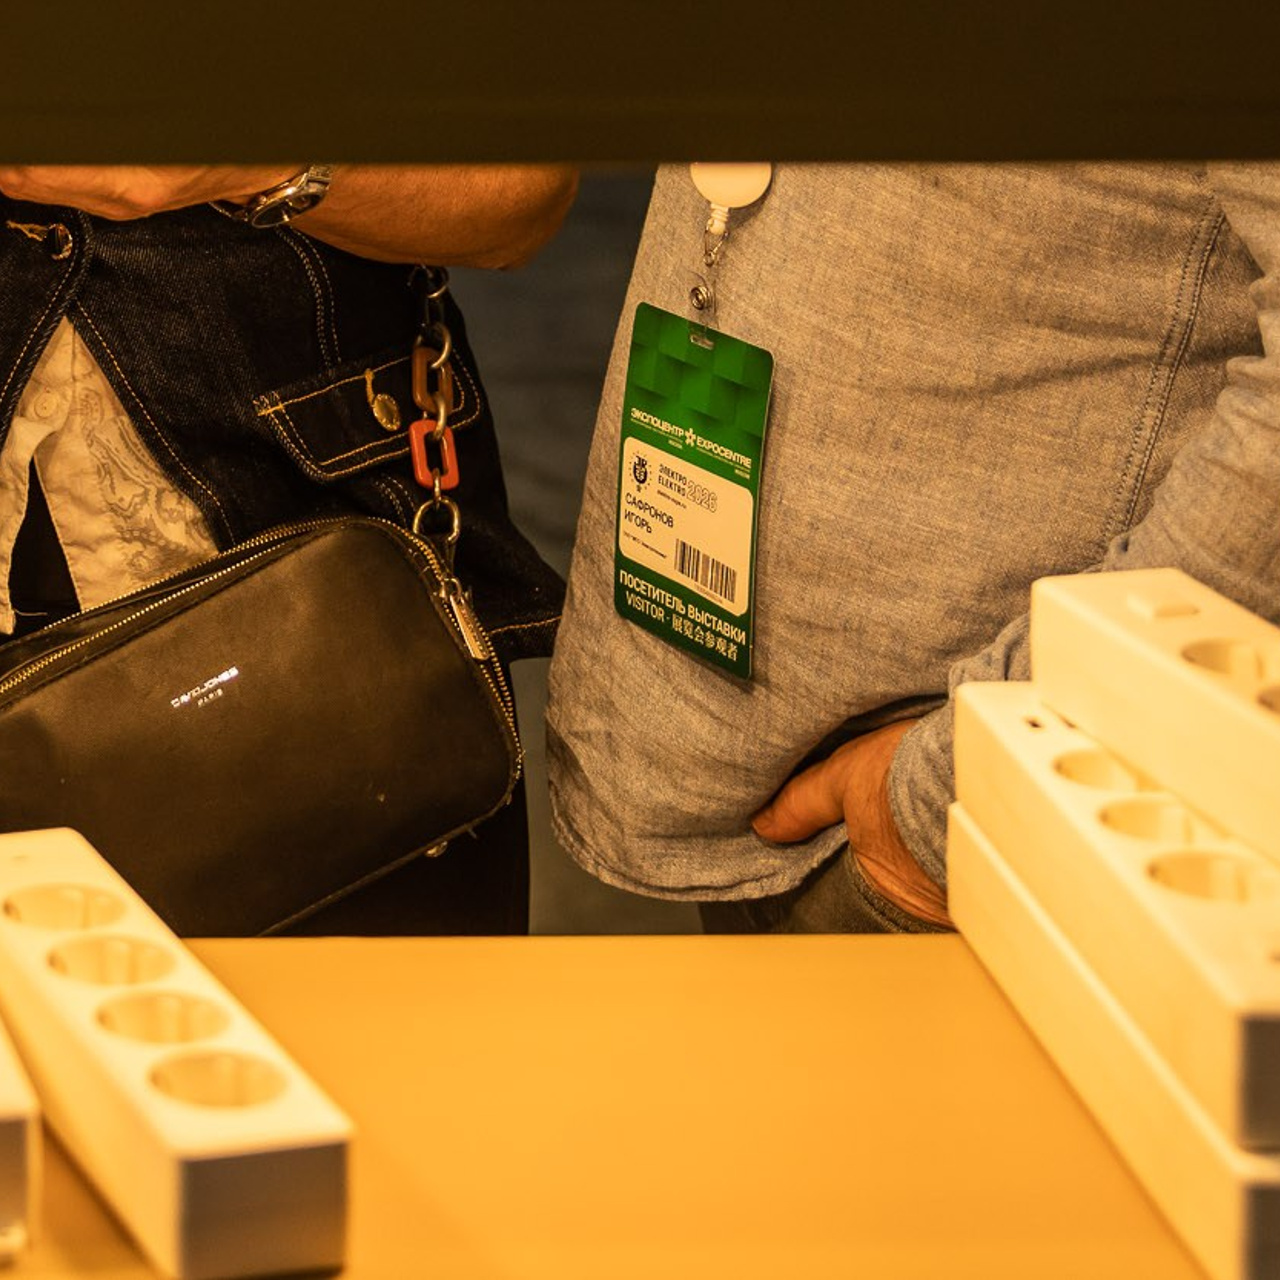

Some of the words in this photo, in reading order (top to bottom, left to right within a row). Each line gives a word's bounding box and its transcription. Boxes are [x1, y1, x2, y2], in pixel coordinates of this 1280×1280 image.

[630, 407, 684, 437] ЭКСПОЦЕНТР
[696, 435, 752, 469] EXPOCENTRE
[658, 475, 686, 497] ELEKTRO
[686, 480, 718, 514] 2026
[624, 509, 652, 534] ИГОРЬ
[625, 492, 674, 528] САФРОНОВ
[619, 569, 686, 615] ПОСЕТИТЕЛЬ
[687, 604, 746, 645] ВЫСТАВКИ
[626, 590, 665, 622] VISITOR
